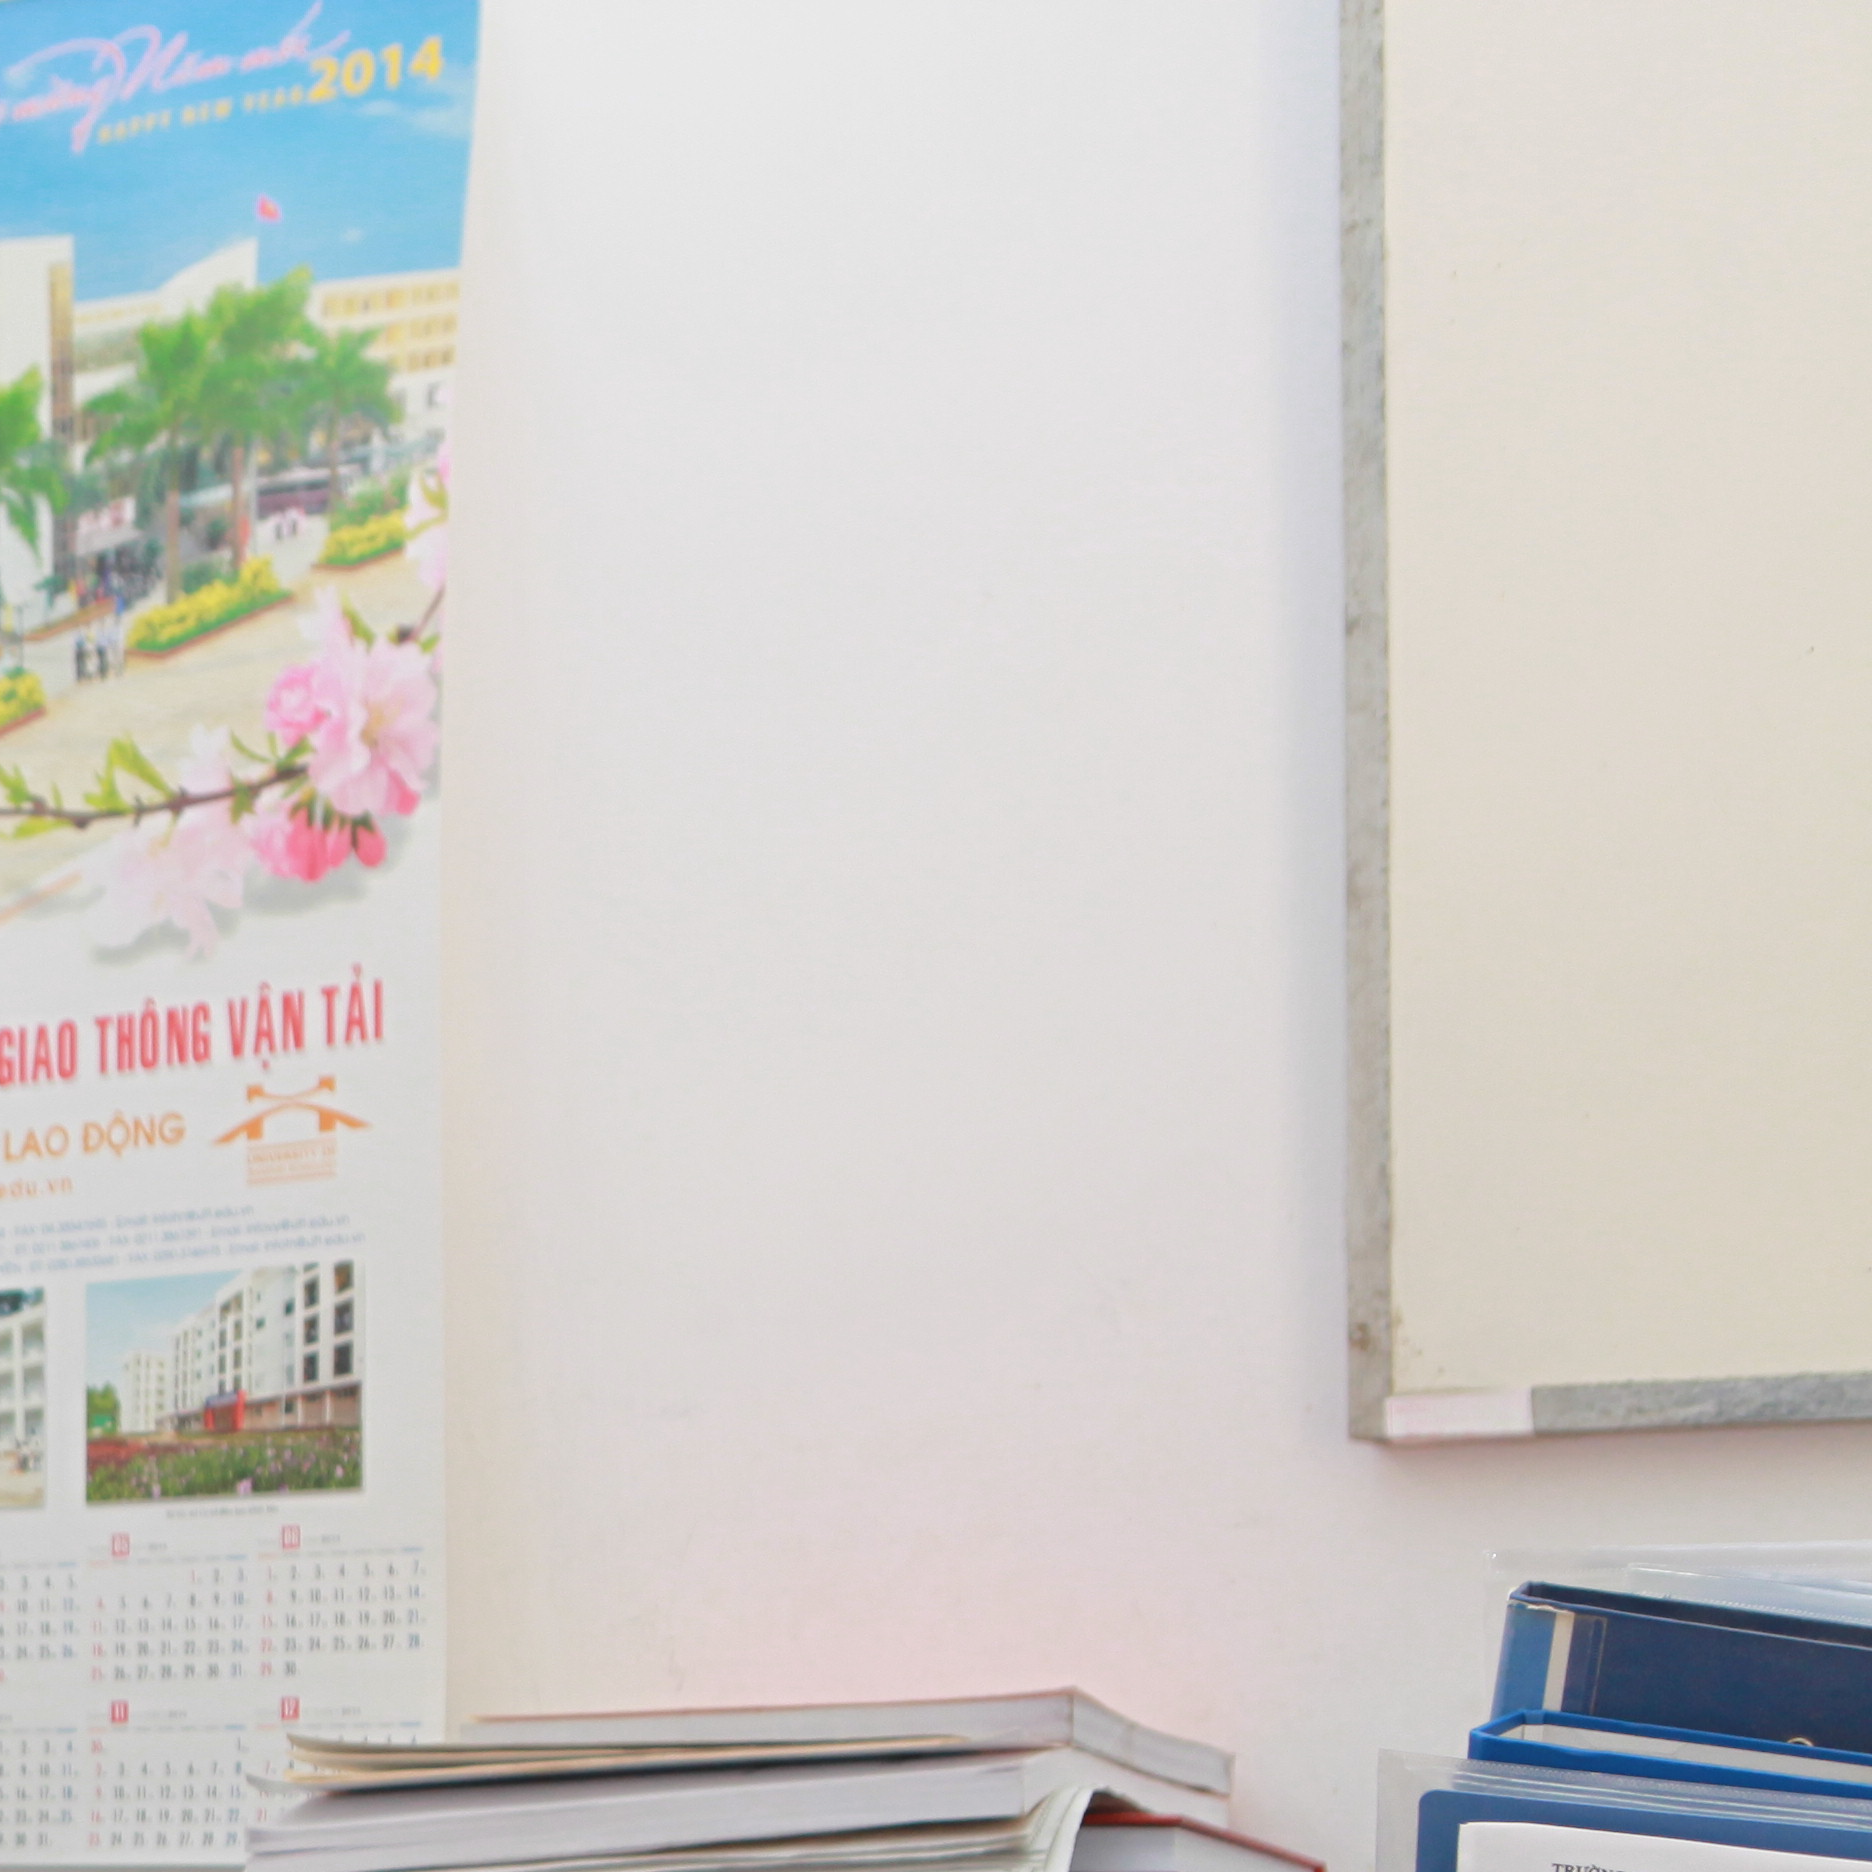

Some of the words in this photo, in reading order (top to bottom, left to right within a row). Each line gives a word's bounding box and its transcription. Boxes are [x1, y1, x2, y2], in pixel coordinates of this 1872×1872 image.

[309, 35, 444, 102] 2014
[182, 99, 233, 126] NEW
[95, 998, 212, 1075] THÔNG
[228, 981, 305, 1070] VẬN
[321, 962, 384, 1047] TẢI
[4, 1125, 70, 1162] LAO
[83, 1110, 187, 1157] ĐỘNG
[310, 1587, 321, 1601] 10
[358, 1587, 370, 1600] 12
[384, 1586, 395, 1599] 13
[408, 1585, 419, 1598] 14
[286, 1612, 296, 1627] 16
[310, 1612, 321, 1627] 17
[335, 1611, 345, 1626] 18
[285, 1637, 296, 1651] 23
[309, 1636, 321, 1650] 24
[358, 1635, 370, 1649] 26
[285, 1661, 296, 1676] 30
